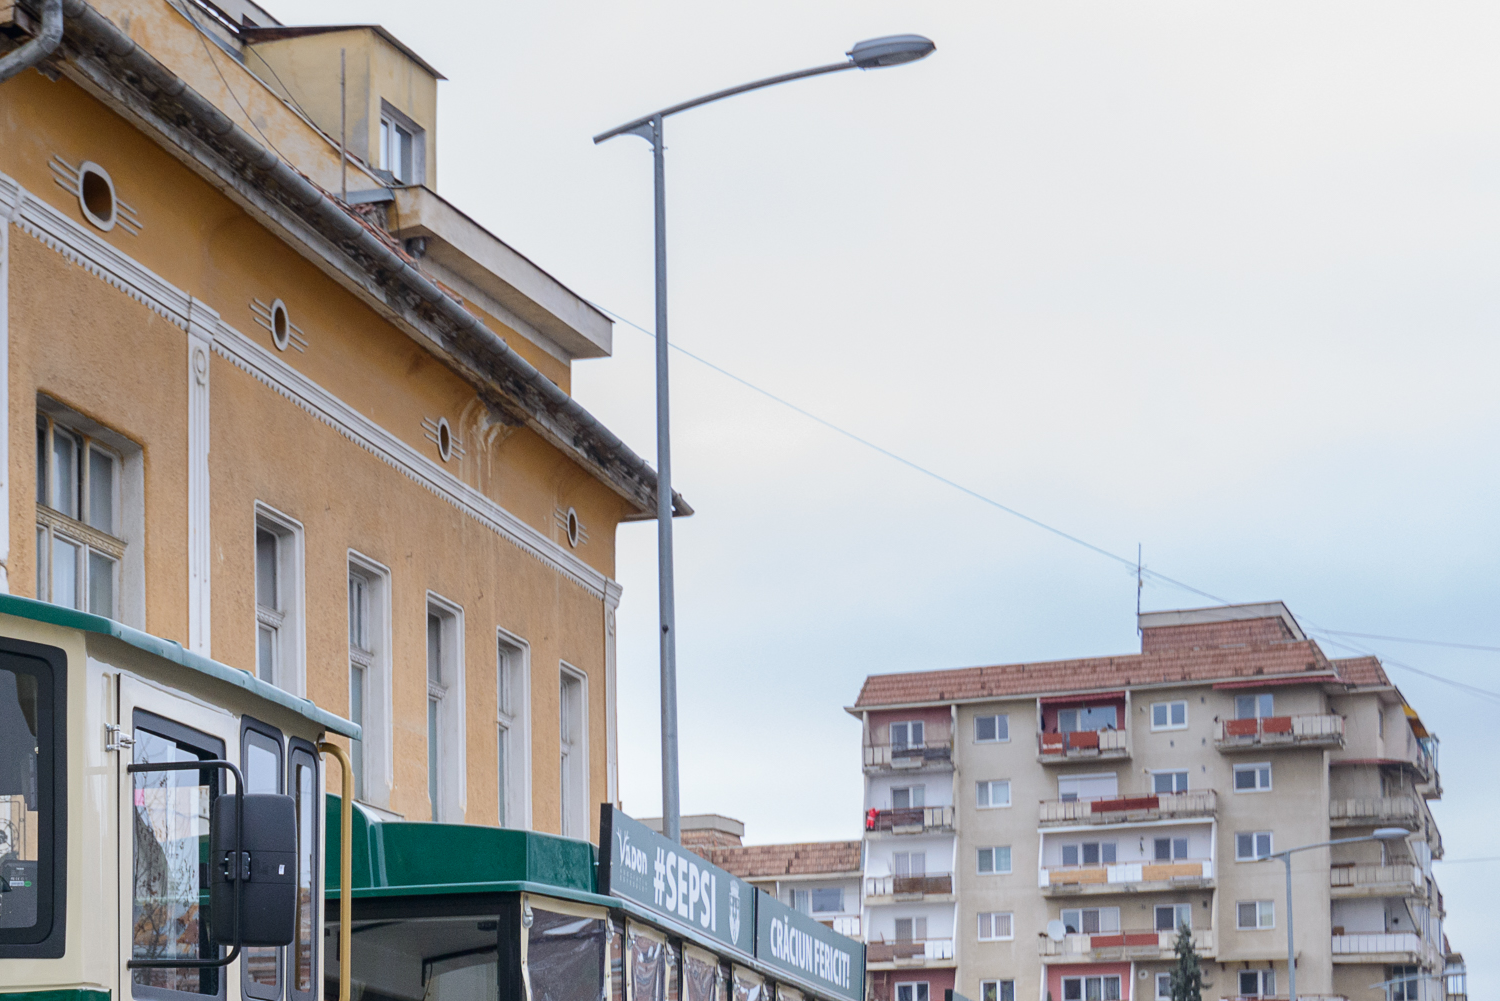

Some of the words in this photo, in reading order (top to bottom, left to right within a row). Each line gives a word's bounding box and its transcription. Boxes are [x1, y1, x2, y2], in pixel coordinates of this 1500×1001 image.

[654, 846, 716, 932] #SEPSI
[770, 914, 813, 973] CRĂCIUN
[815, 938, 850, 990] FERICIT!
